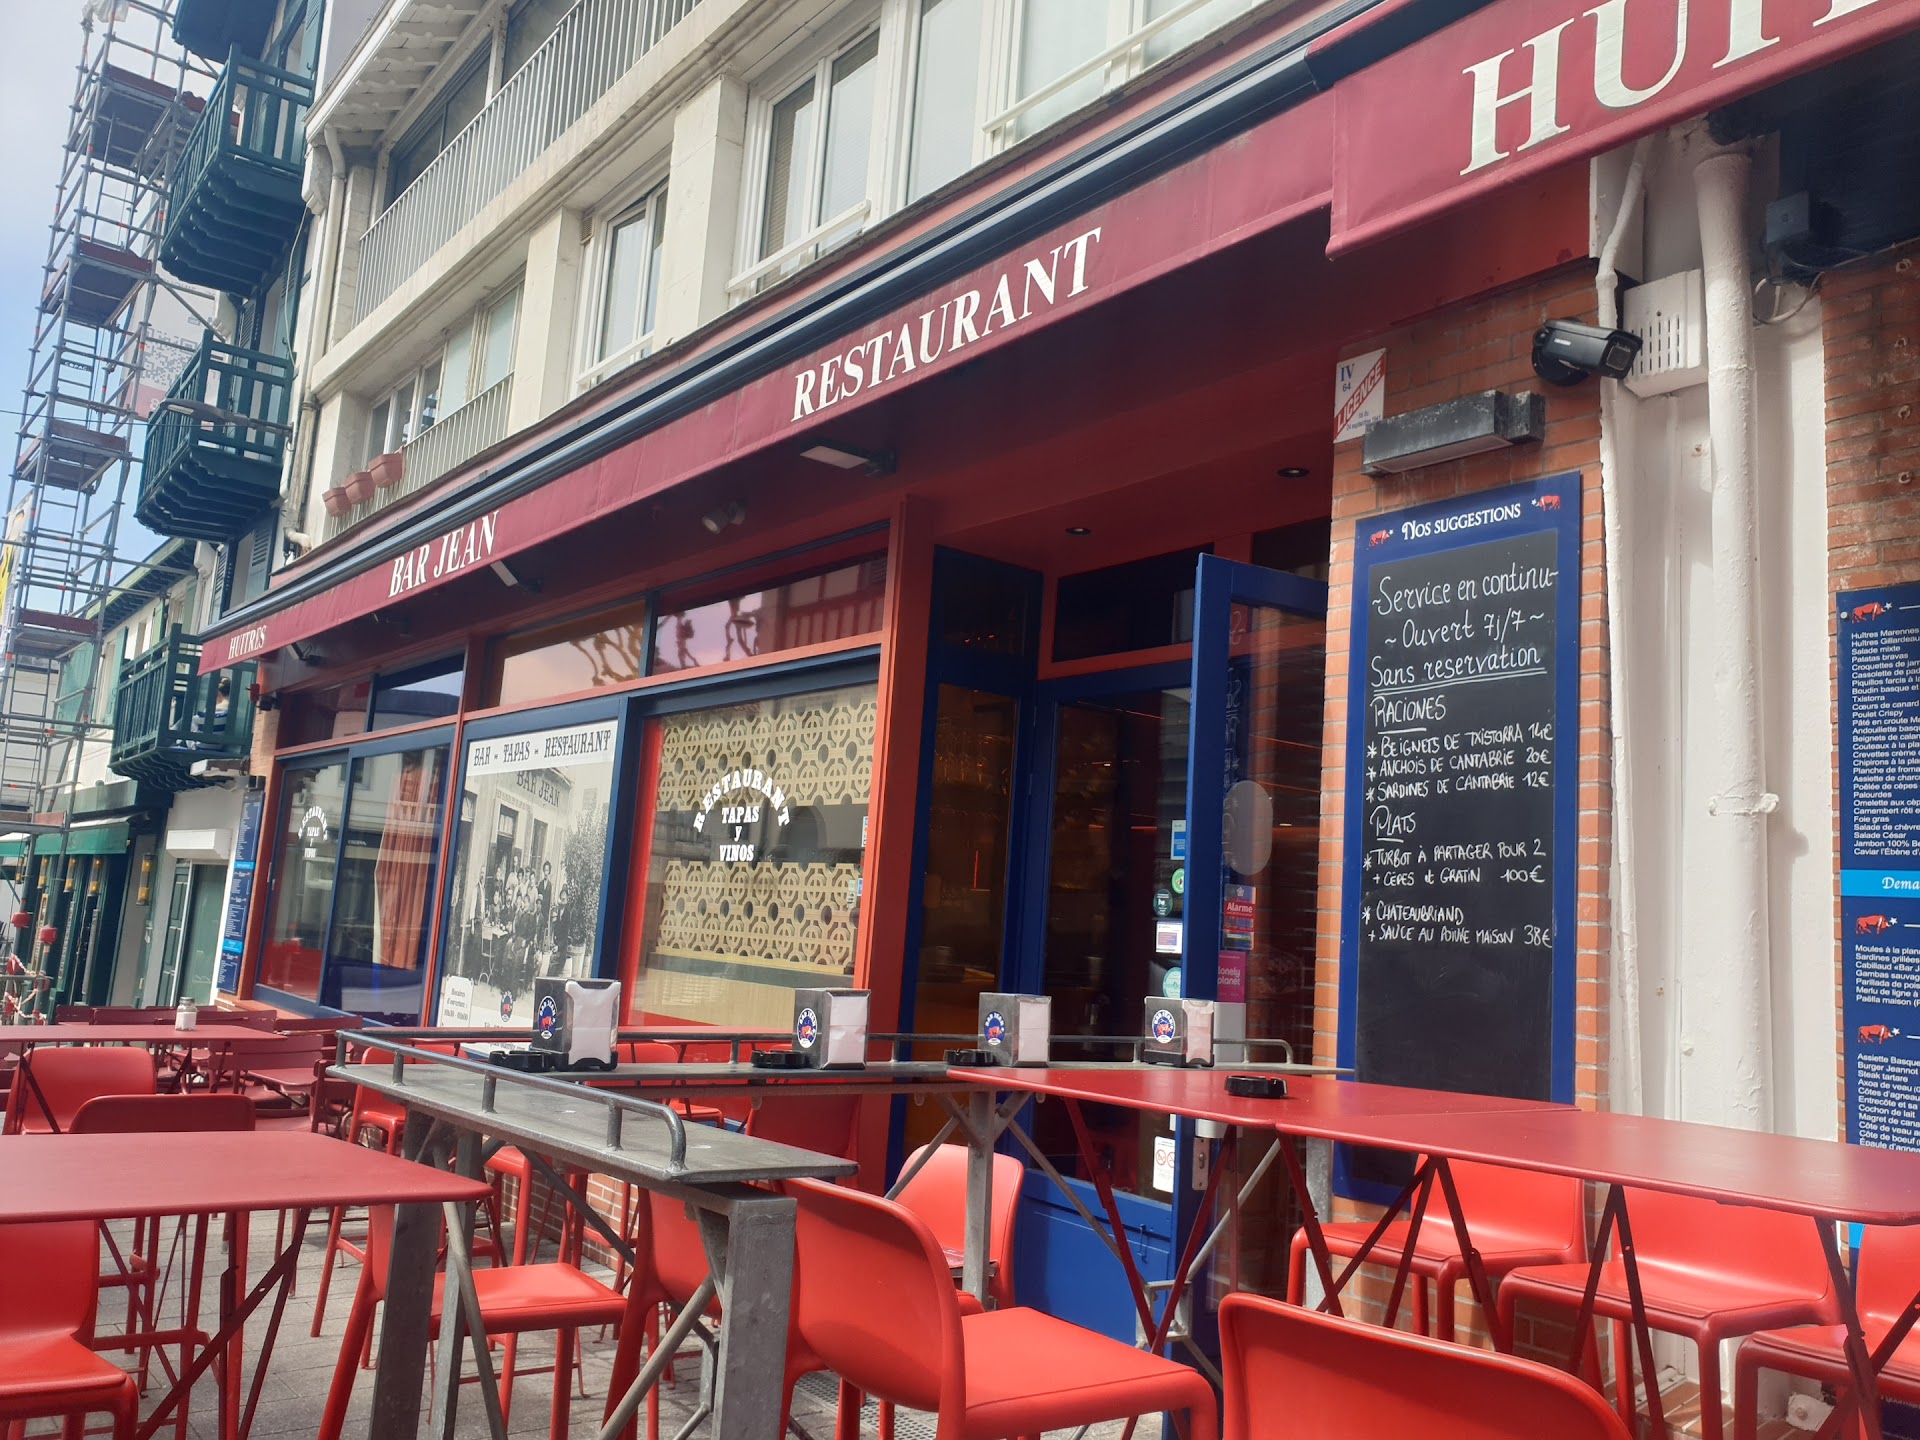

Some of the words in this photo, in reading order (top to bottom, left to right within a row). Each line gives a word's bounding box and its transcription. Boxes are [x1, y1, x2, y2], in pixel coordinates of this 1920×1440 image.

[1459, 0, 1881, 176] HUI
[790, 226, 1102, 423] RESTAURANT
[1340, 363, 1355, 381] IV
[1337, 359, 1381, 433] LICENCE
[1434, 503, 1522, 533] SUGGESTIONS
[388, 544, 431, 598] BAR
[433, 509, 501, 579] JEAN
[1457, 580, 1477, 601] en
[1880, 628, 1920, 637] Marennes
[1852, 647, 1878, 656] Salade
[1370, 656, 1415, 688] Sans
[1424, 645, 1541, 681] reservation
[1852, 656, 1880, 664] Patatas
[1852, 662, 1894, 672] Croquettes
[1852, 670, 1892, 679] Cassolette
[1852, 679, 1884, 688] Piquillos
[1852, 687, 1878, 695] Boudin
[1880, 686, 1910, 694] basque
[1892, 700, 1920, 708] canard
[1370, 694, 1446, 728] RACIONES
[1852, 726, 1898, 734] Andouillette
[1380, 735, 1440, 758] BEIGNETS
[1444, 733, 1461, 750] DE
[1464, 724, 1524, 748] TXISTORRA
[1852, 734, 1886, 743] Beignets
[473, 746, 491, 767] BAR
[503, 740, 530, 763] TAPAS
[544, 729, 612, 758] RESTAURANT
[1380, 758, 1426, 778] ANCHOIS
[1430, 756, 1444, 774] DE
[1450, 748, 1515, 771] CANTABRIE
[1526, 747, 1552, 765] 20€
[1852, 759, 1889, 767] Chipirons
[516, 770, 537, 795] BAR
[538, 780, 560, 807] JEAN
[1377, 782, 1429, 801] SARDINES
[1436, 778, 1450, 794] DE
[1455, 773, 1515, 792] CANTABRIE
[1522, 771, 1550, 788] 12€
[693, 768, 790, 833] RESTAURANT
[721, 806, 760, 824] TAPAS
[1370, 804, 1416, 837] PLATS
[720, 844, 754, 862] VINOS
[1372, 848, 1413, 868] TURBOT
[1434, 842, 1493, 862] PARTAGER
[1498, 841, 1527, 858] POUR
[1532, 838, 1546, 856] 2
[1440, 866, 1481, 884] GRATIN
[1226, 902, 1253, 914] Alarme
[1376, 900, 1464, 926] CHATEAUBRIAND
[1379, 922, 1415, 941] SAUCE
[1418, 926, 1434, 942] AU
[1476, 928, 1515, 944] MAISON
[1524, 924, 1552, 948] 38€
[1855, 944, 1884, 952] Moules
[1856, 953, 1890, 962] Sardines
[1218, 966, 1240, 978] lonely
[1856, 961, 1892, 970] Cabillaud
[1856, 970, 1889, 978] Gambas
[1856, 986, 1878, 994] Merlu
[1892, 988, 1912, 998] ligne
[1882, 998, 1912, 1006] maison
[1857, 1053, 1889, 1063] Assiette
[1858, 1062, 1884, 1072] Burger
[1886, 1065, 1918, 1074] Jeannot
[1858, 1070, 1880, 1079] Steak
[1882, 1074, 1909, 1082] tartare
[1858, 1078, 1878, 1088] Axoa
[1892, 1084, 1912, 1092] veau
[1858, 1104, 1890, 1114] Cochon
[1904, 1110, 1916, 1118] lait
[1858, 1112, 1887, 1123] Magret
[1892, 1127, 1912, 1135] veau
